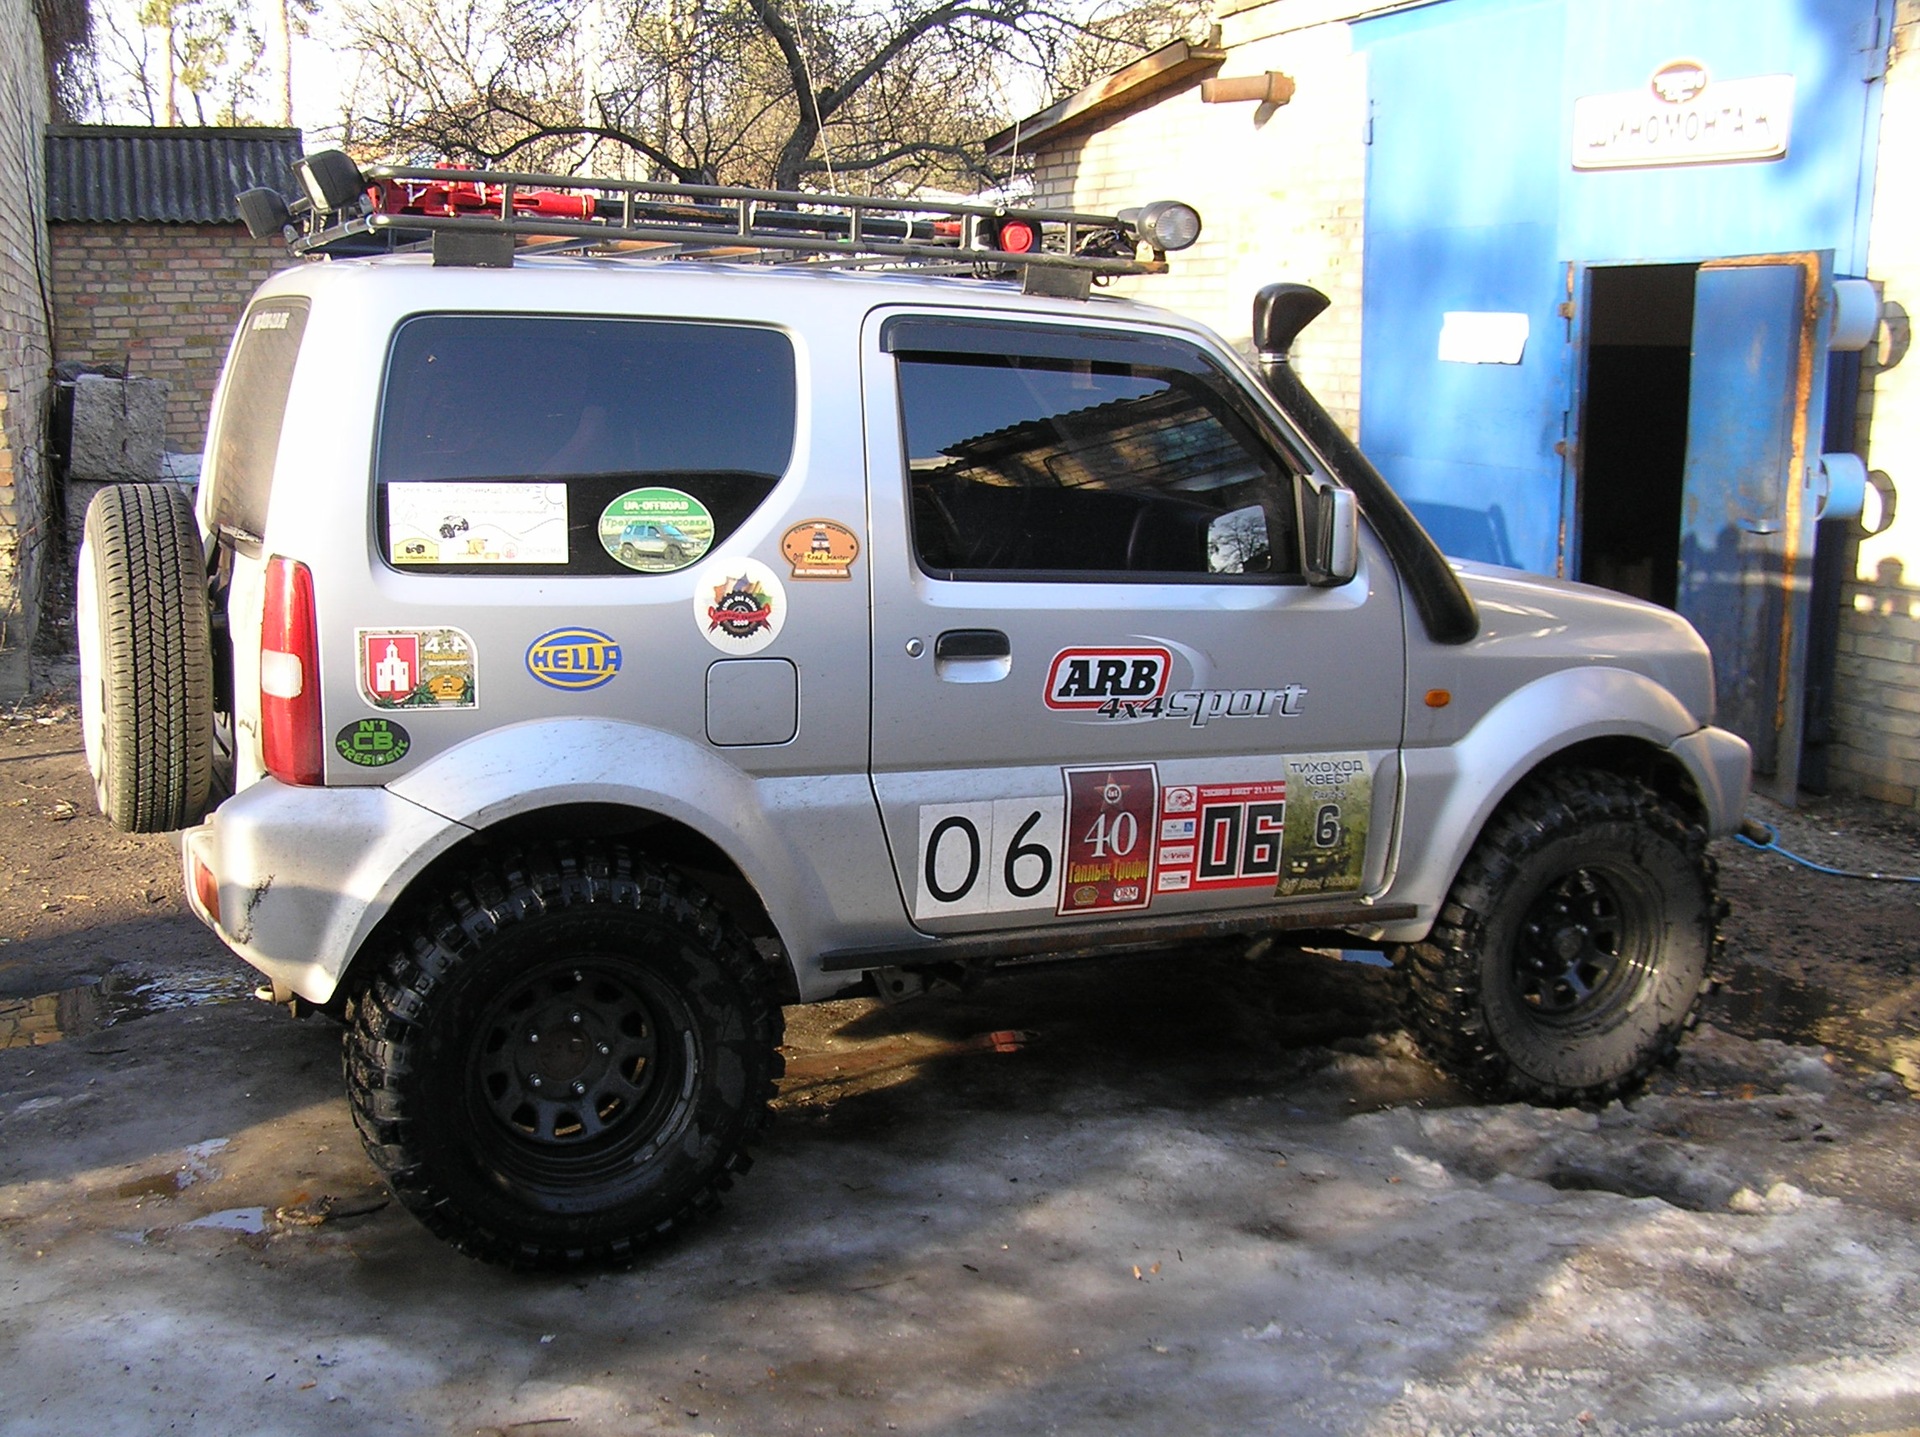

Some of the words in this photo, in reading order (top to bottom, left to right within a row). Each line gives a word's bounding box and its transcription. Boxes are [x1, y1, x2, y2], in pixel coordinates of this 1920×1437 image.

[424, 636, 468, 653] 4x4
[533, 645, 622, 673] HELLA
[1057, 659, 1159, 697] ARB
[1097, 697, 1164, 719] 4x4
[1164, 682, 1308, 729] sport
[353, 732, 393, 751] CB
[1289, 760, 1364, 773] ТИХОХОД
[1304, 773, 1352, 786] КВЕСТ
[1083, 811, 1138, 857] 40
[1196, 801, 1285, 882] 06
[1314, 803, 1341, 848] 6
[924, 809, 1053, 903] 06
[1113, 858, 1148, 882] Трофи
